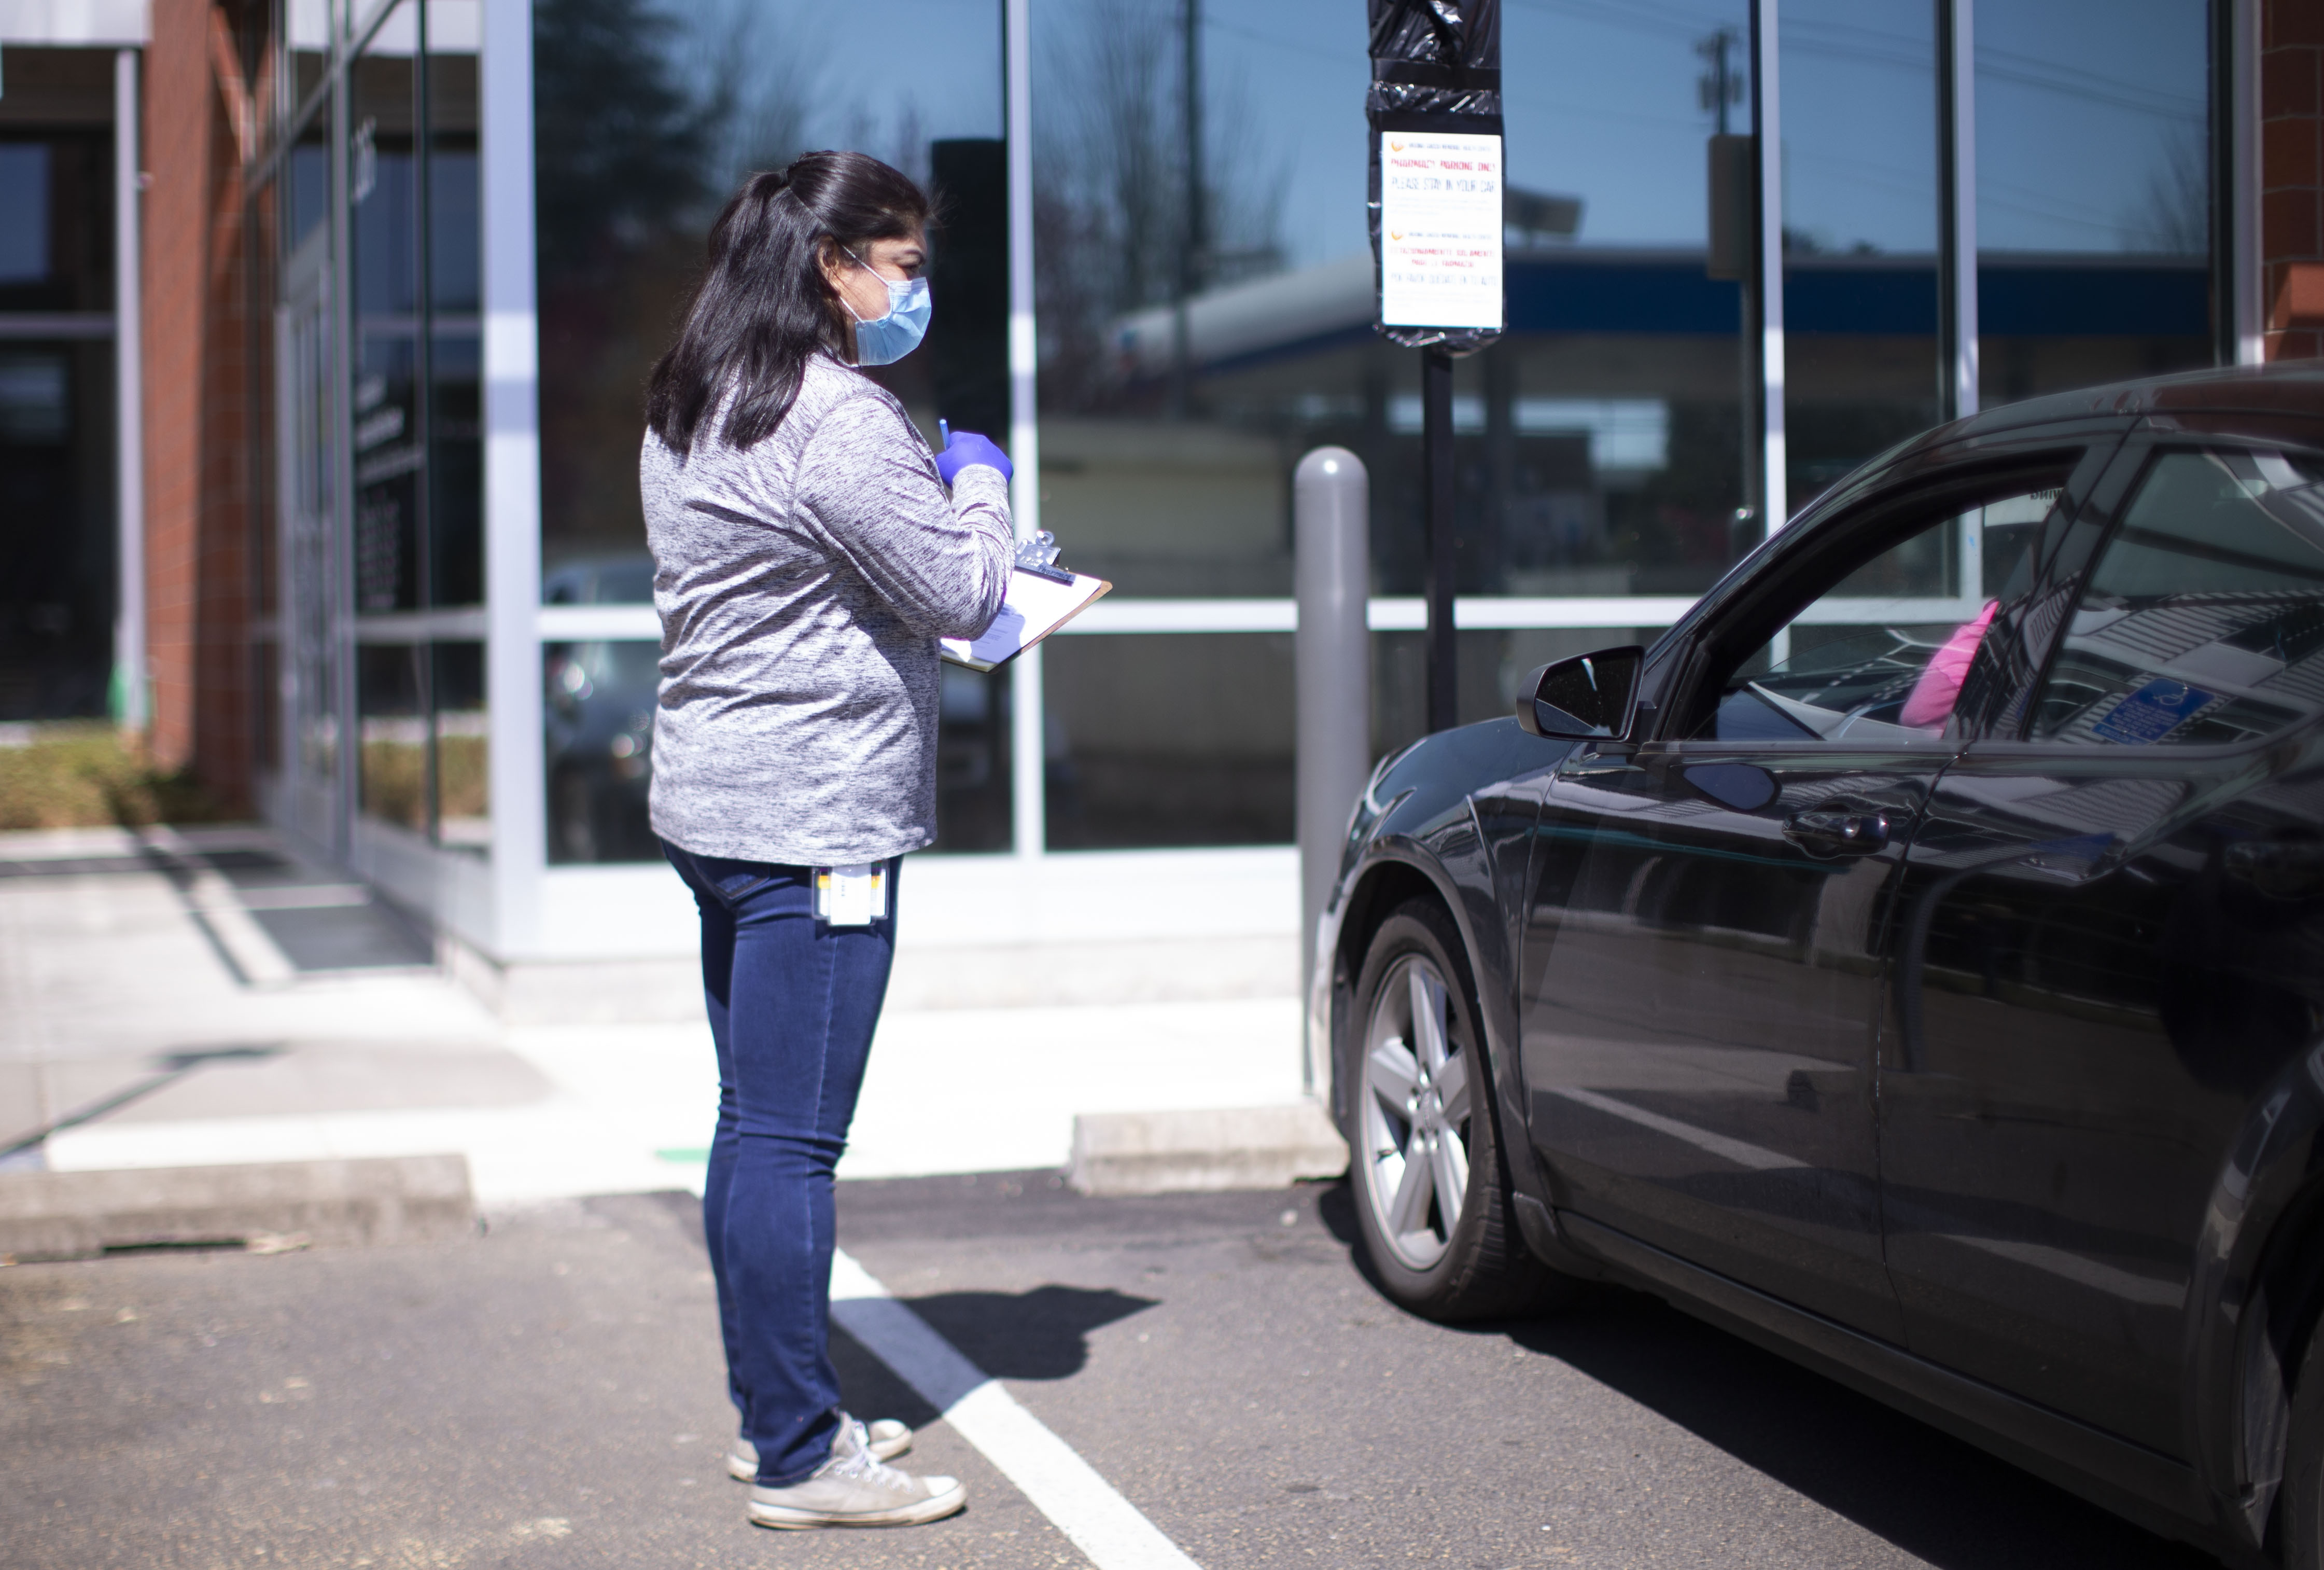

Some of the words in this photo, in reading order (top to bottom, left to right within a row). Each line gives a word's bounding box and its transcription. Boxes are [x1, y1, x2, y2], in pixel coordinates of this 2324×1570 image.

[1392, 176, 1419, 190] PLEASE
[1424, 177, 1441, 190] STAY
[1446, 178, 1452, 191] IN
[1457, 179, 1477, 192] YOUR
[1481, 180, 1495, 193] CAR
